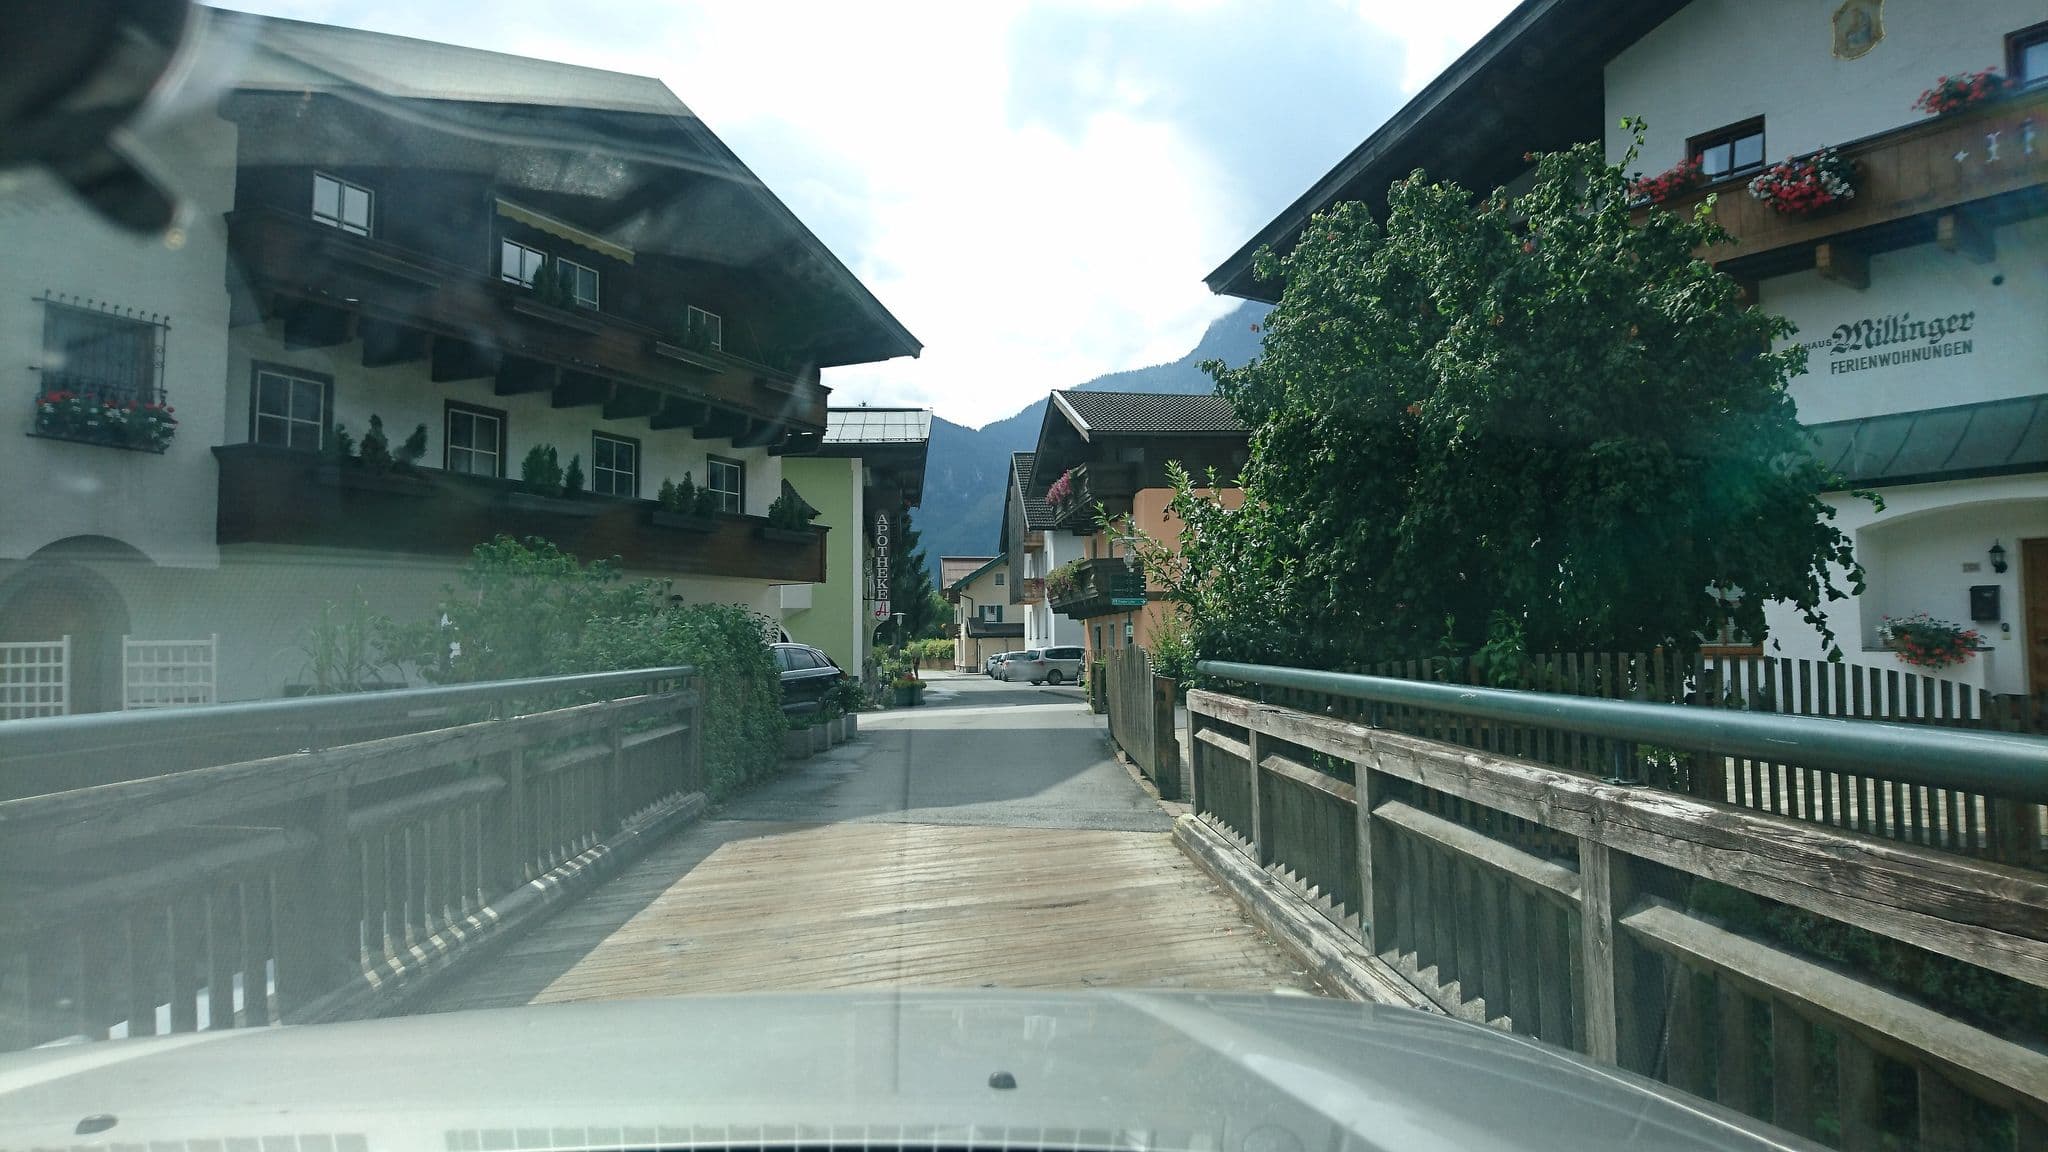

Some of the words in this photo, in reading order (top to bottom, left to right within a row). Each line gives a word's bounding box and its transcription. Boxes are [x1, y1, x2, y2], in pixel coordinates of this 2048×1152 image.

[1830, 310, 1976, 356] Millinger
[1830, 339, 1973, 375] FERIENWOHNUNGEN
[876, 513, 889, 600] APOTHEKE
